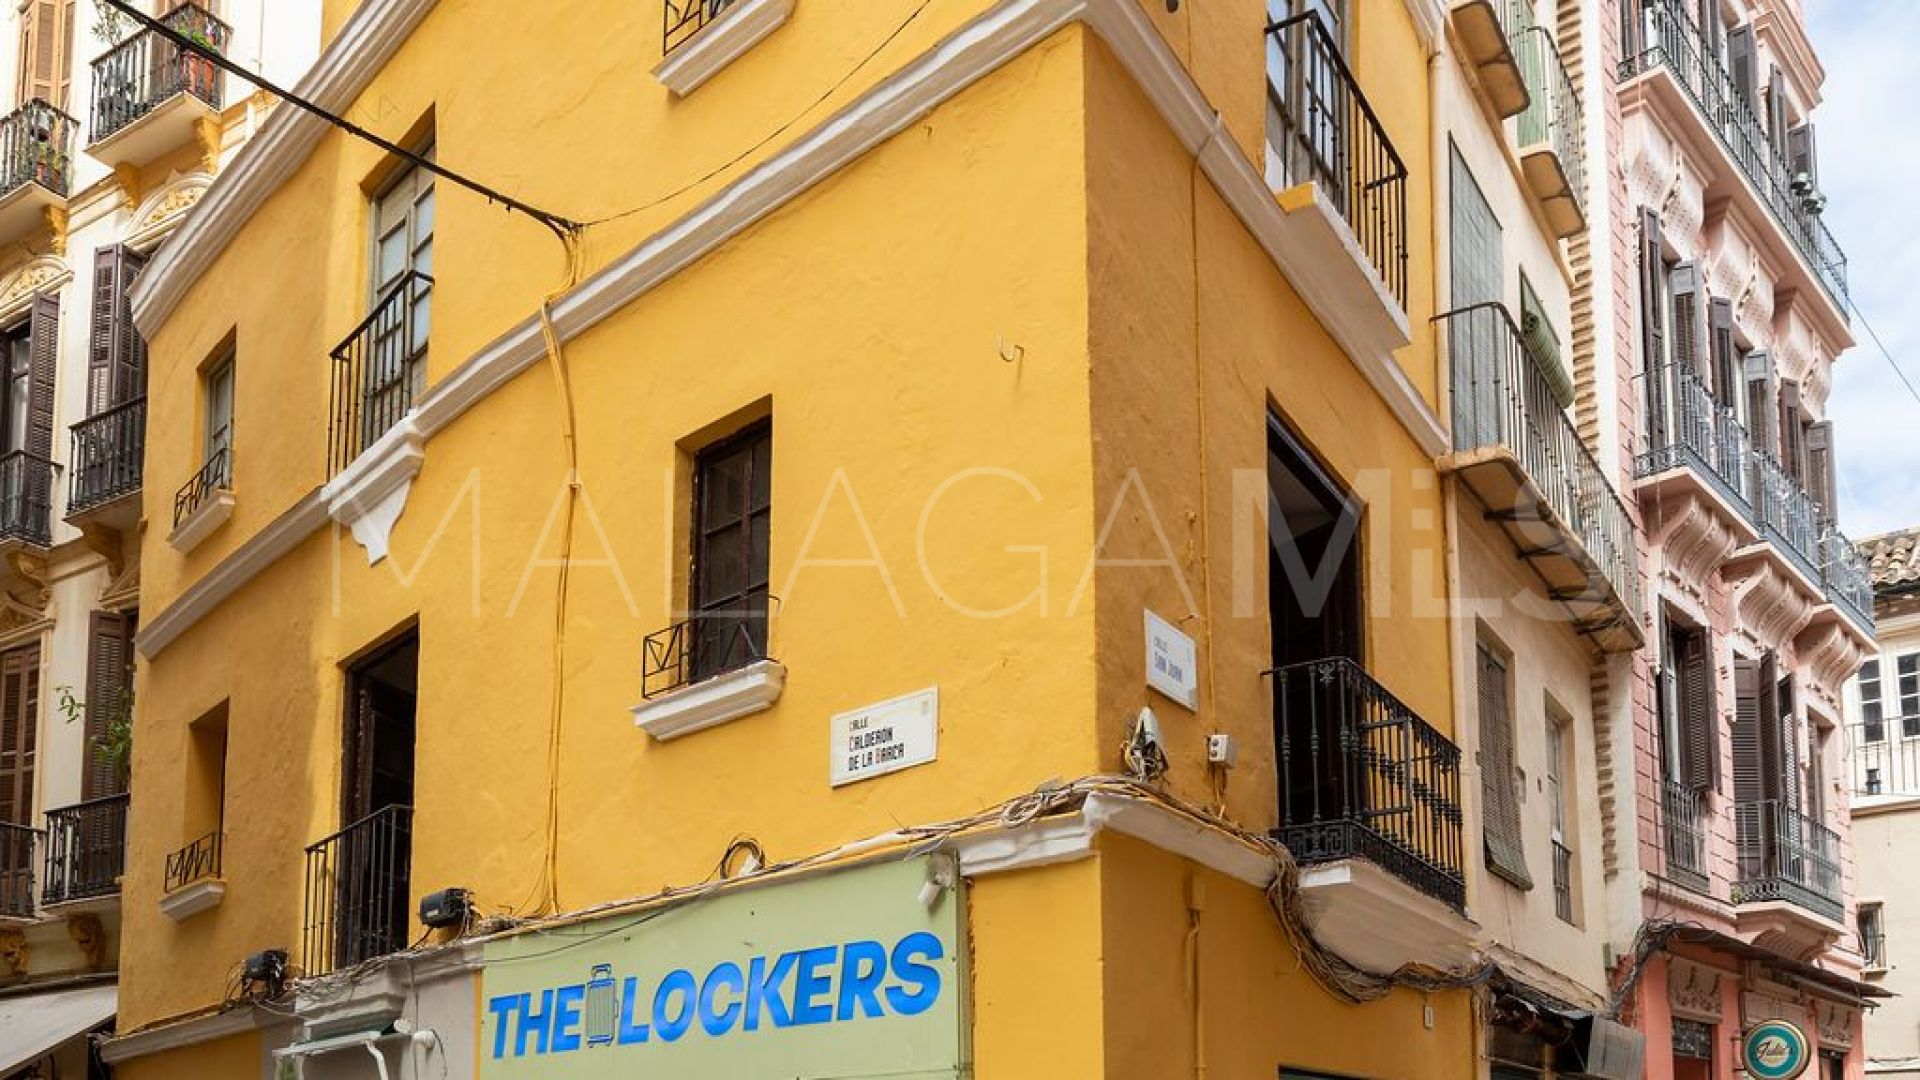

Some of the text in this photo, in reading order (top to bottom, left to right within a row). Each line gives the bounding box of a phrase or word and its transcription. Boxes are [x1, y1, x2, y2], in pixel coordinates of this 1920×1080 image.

[849, 716, 868, 731] CALLE
[849, 742, 904, 771] DE LA BARCA
[489, 931, 944, 1060] THE LOCKERS
